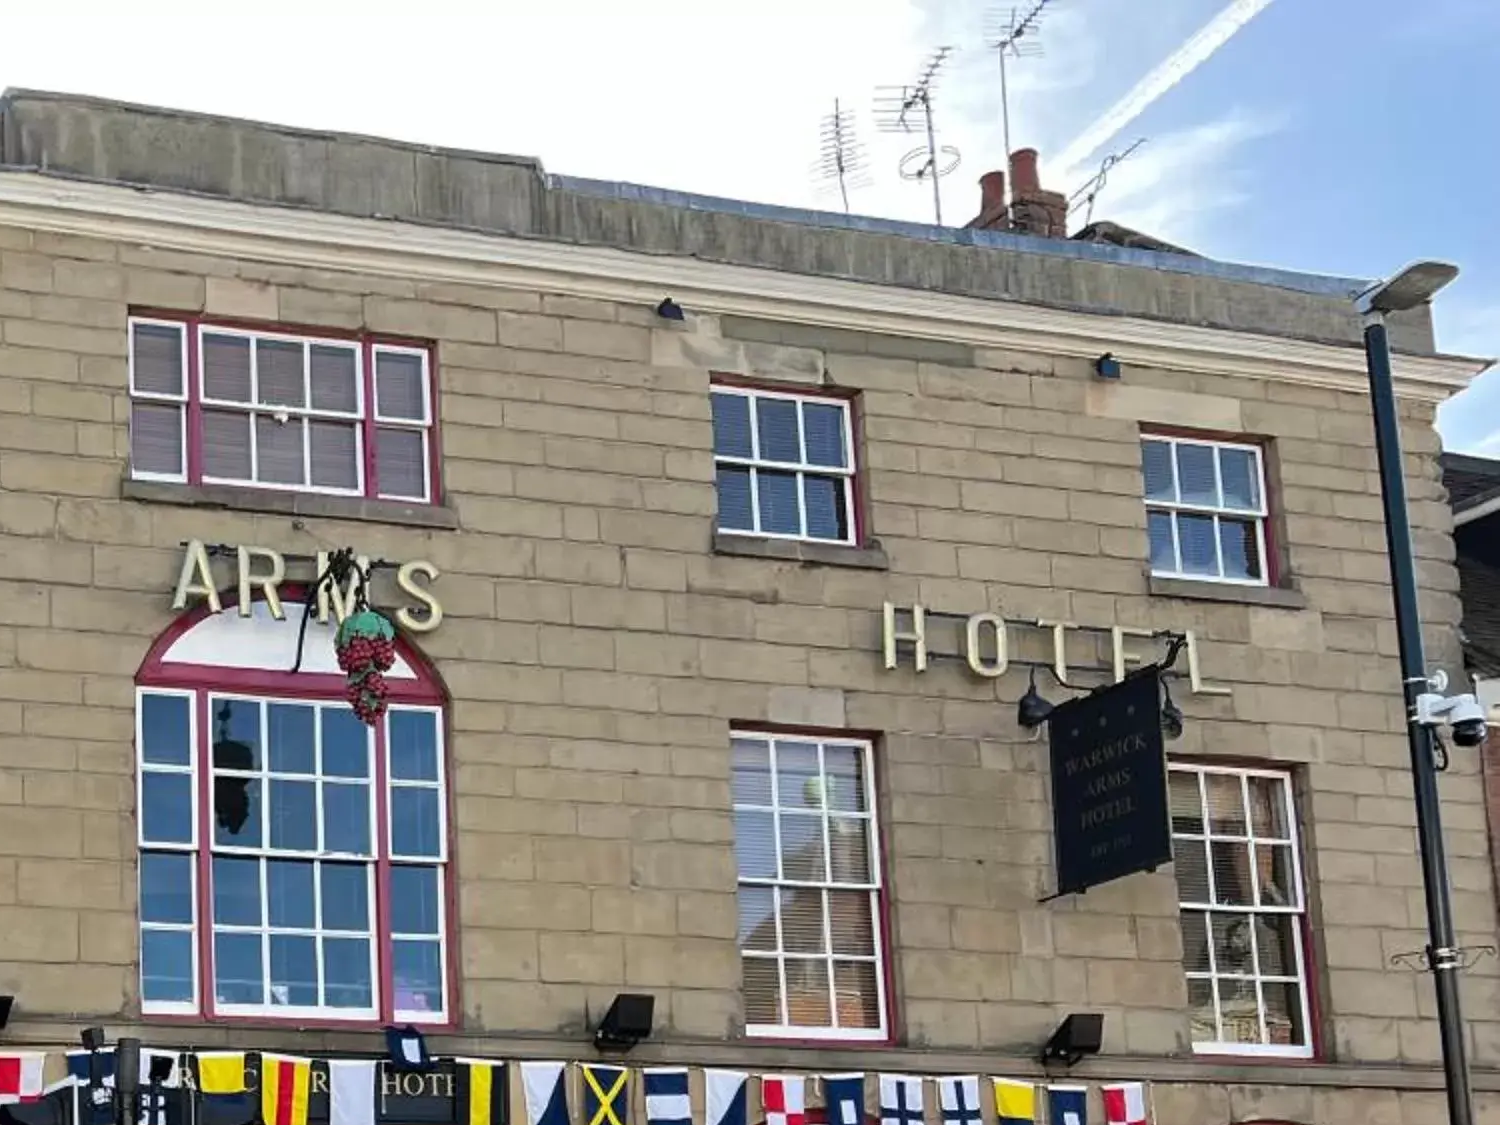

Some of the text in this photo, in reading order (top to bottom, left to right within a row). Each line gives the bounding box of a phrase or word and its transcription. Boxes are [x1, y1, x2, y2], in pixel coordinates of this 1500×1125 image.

[172, 539, 444, 633] ARMS
[883, 600, 1232, 697] HOTEL
[1064, 732, 1148, 777] WARWICK
[1084, 766, 1132, 798] ARMS
[1080, 795, 1137, 831] HOTEL
